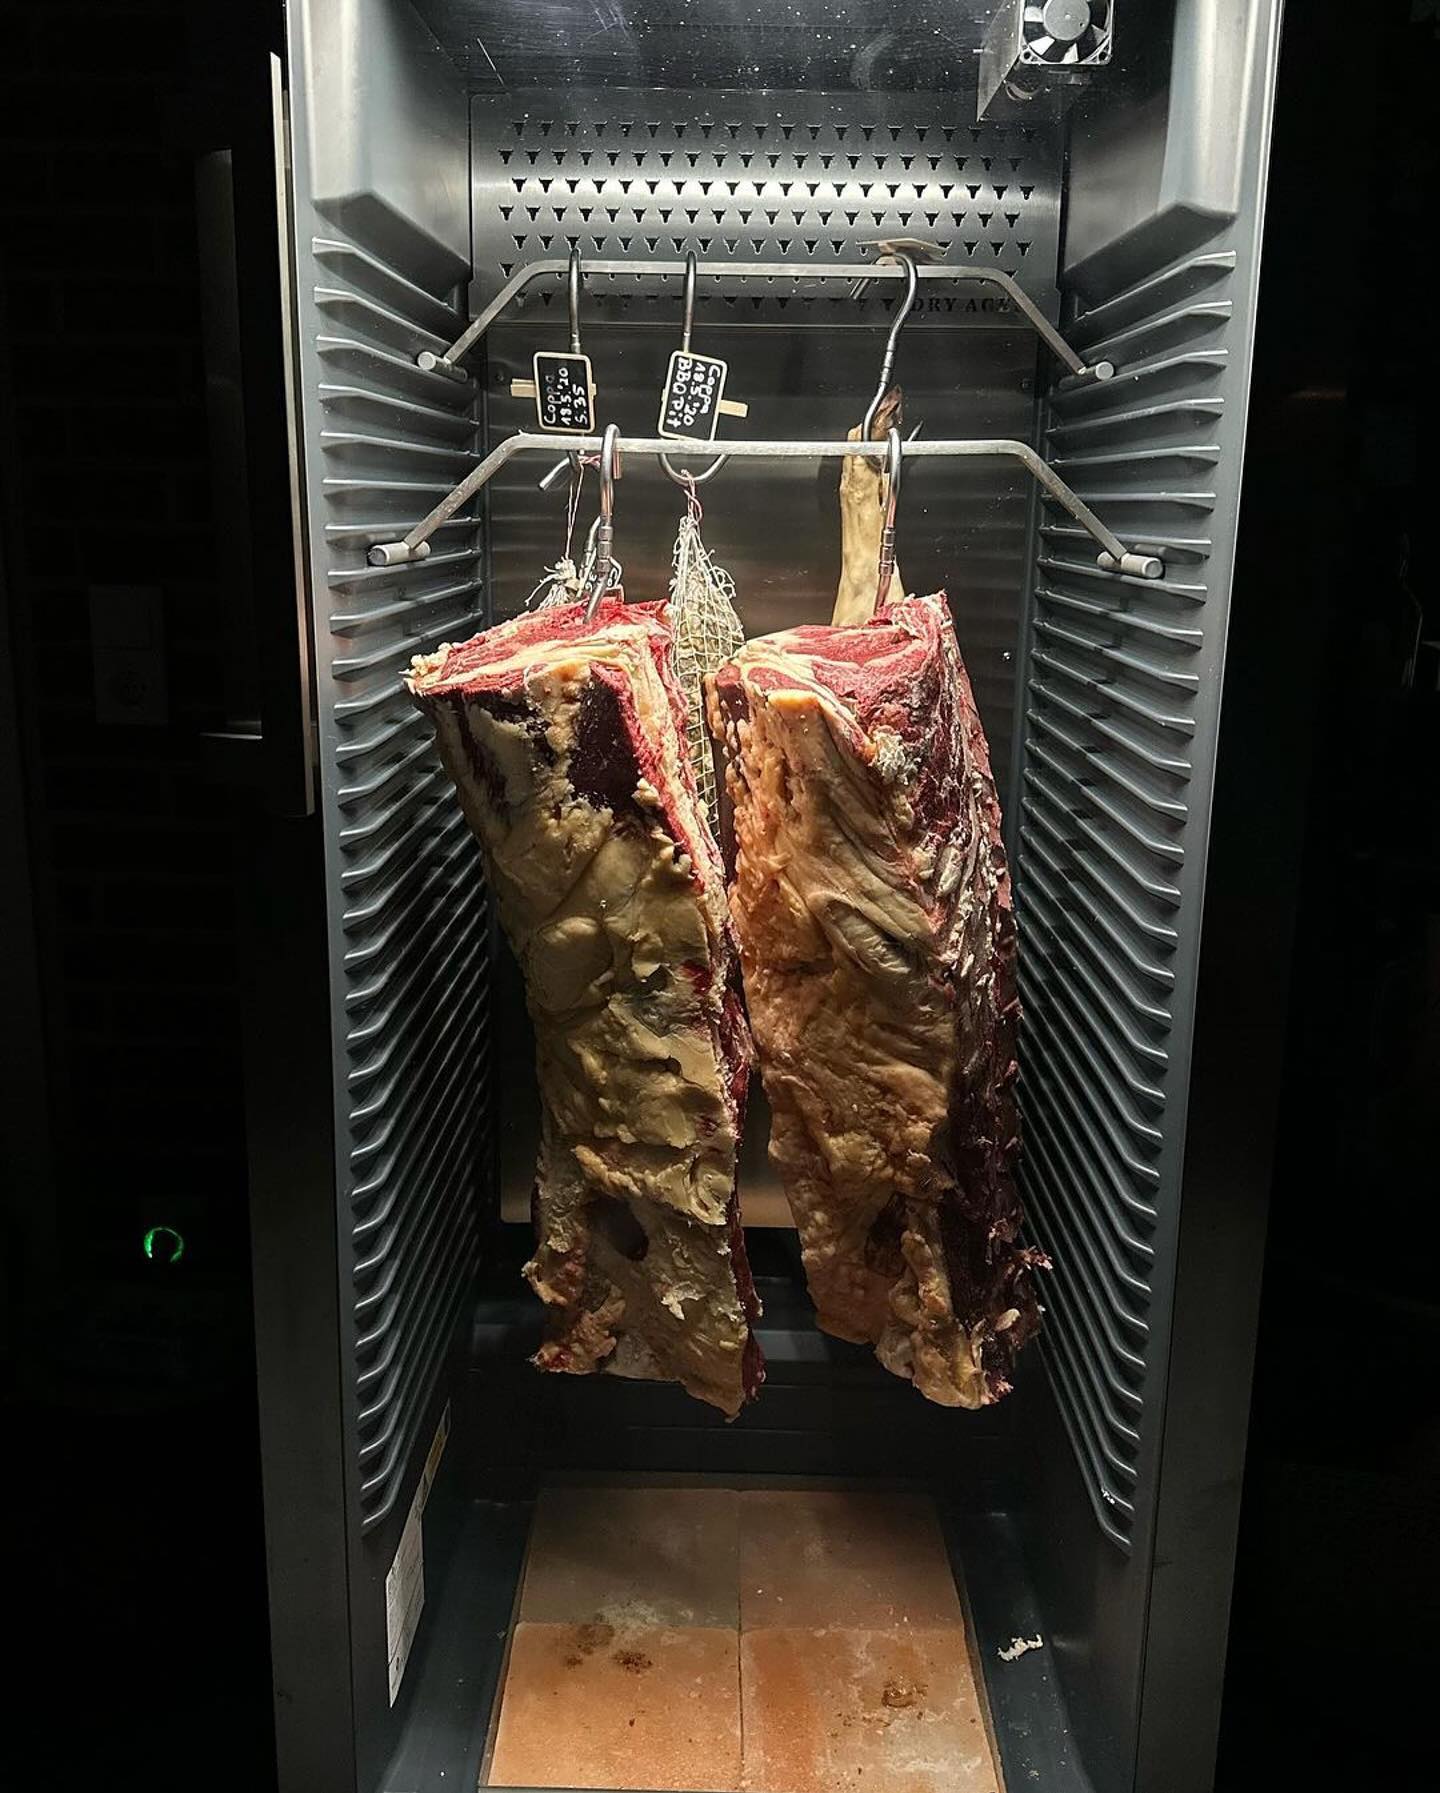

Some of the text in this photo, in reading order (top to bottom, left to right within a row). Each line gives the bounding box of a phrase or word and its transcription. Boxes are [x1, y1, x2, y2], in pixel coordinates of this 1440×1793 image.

[911, 298, 956, 312] DRY
[672, 357, 693, 394] BBQ
[698, 364, 720, 414] Coppa
[544, 375, 561, 424] Coppa
[572, 384, 588, 425] 5.35
